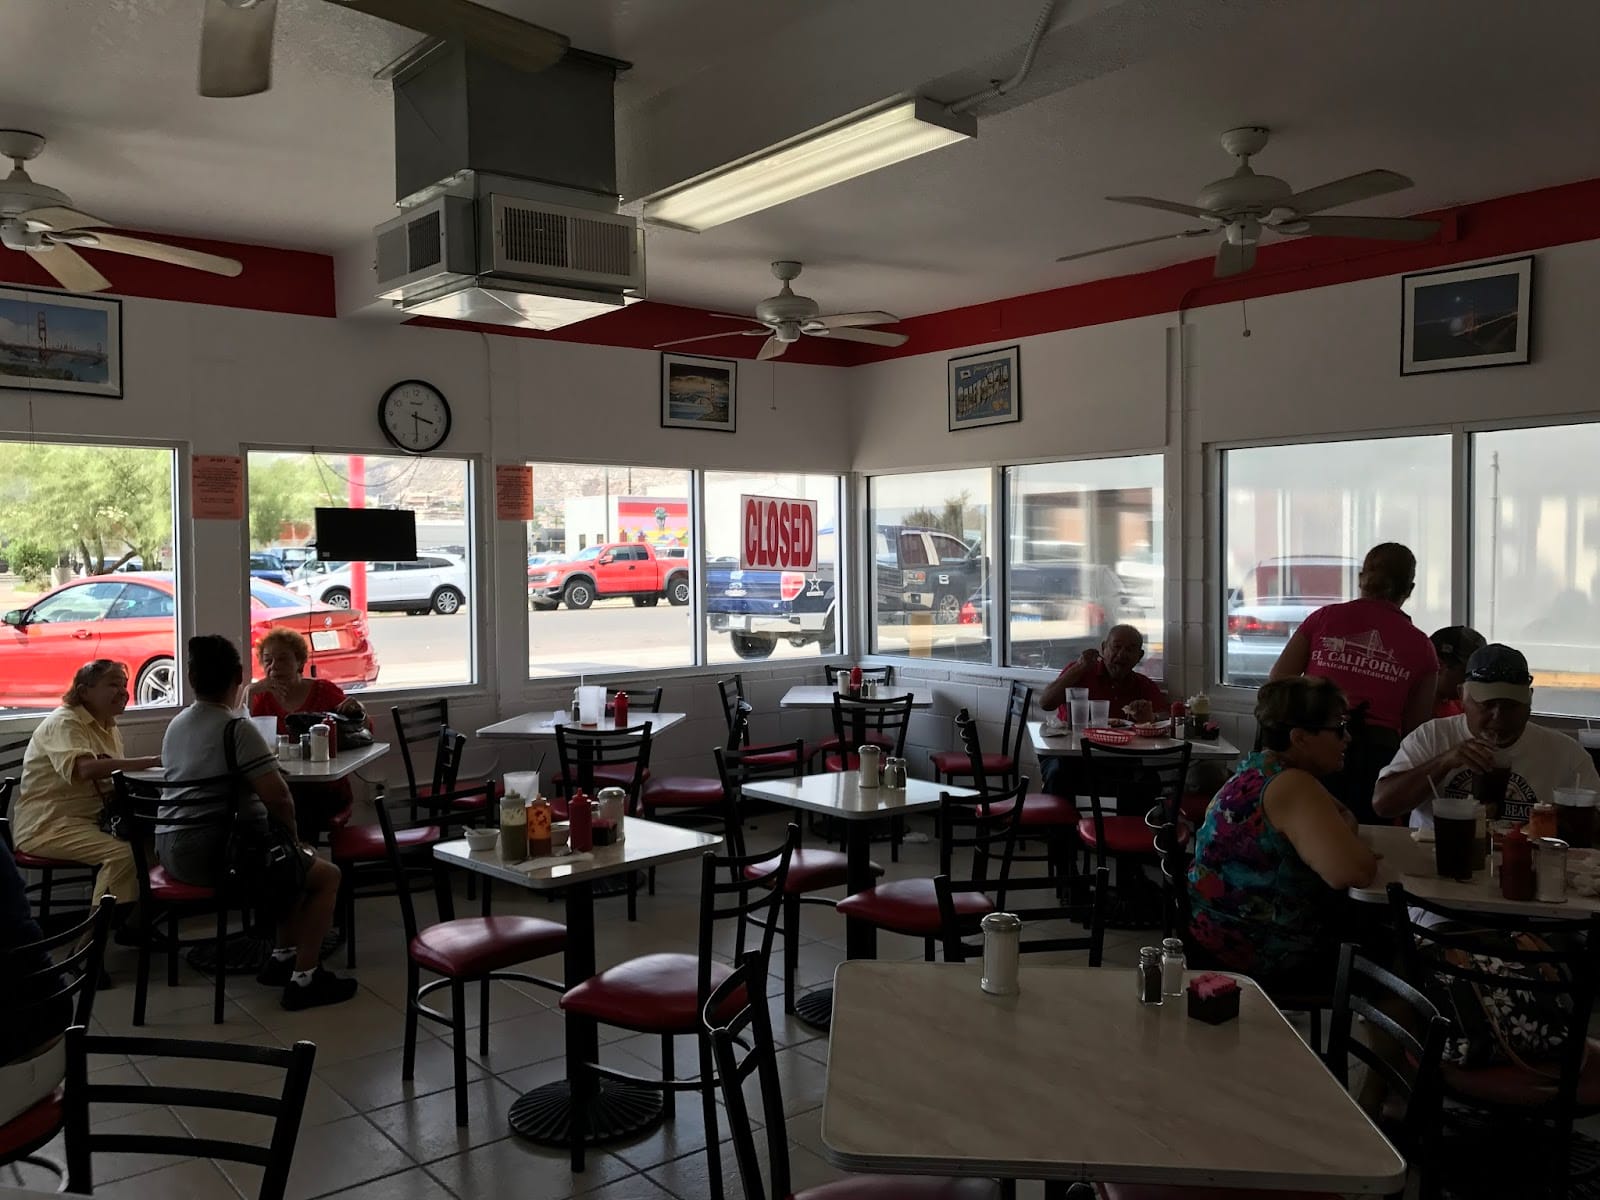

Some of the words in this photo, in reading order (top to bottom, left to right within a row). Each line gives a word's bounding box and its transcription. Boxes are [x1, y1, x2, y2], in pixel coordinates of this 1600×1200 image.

[745, 498, 813, 568] CLOSED
[1311, 650, 1324, 661] EL
[1328, 651, 1411, 681] CALIFORNIA
[1317, 659, 1349, 671] Mexican
[1352, 666, 1398, 683] Restaurant
[1504, 803, 1531, 818] BEAC
